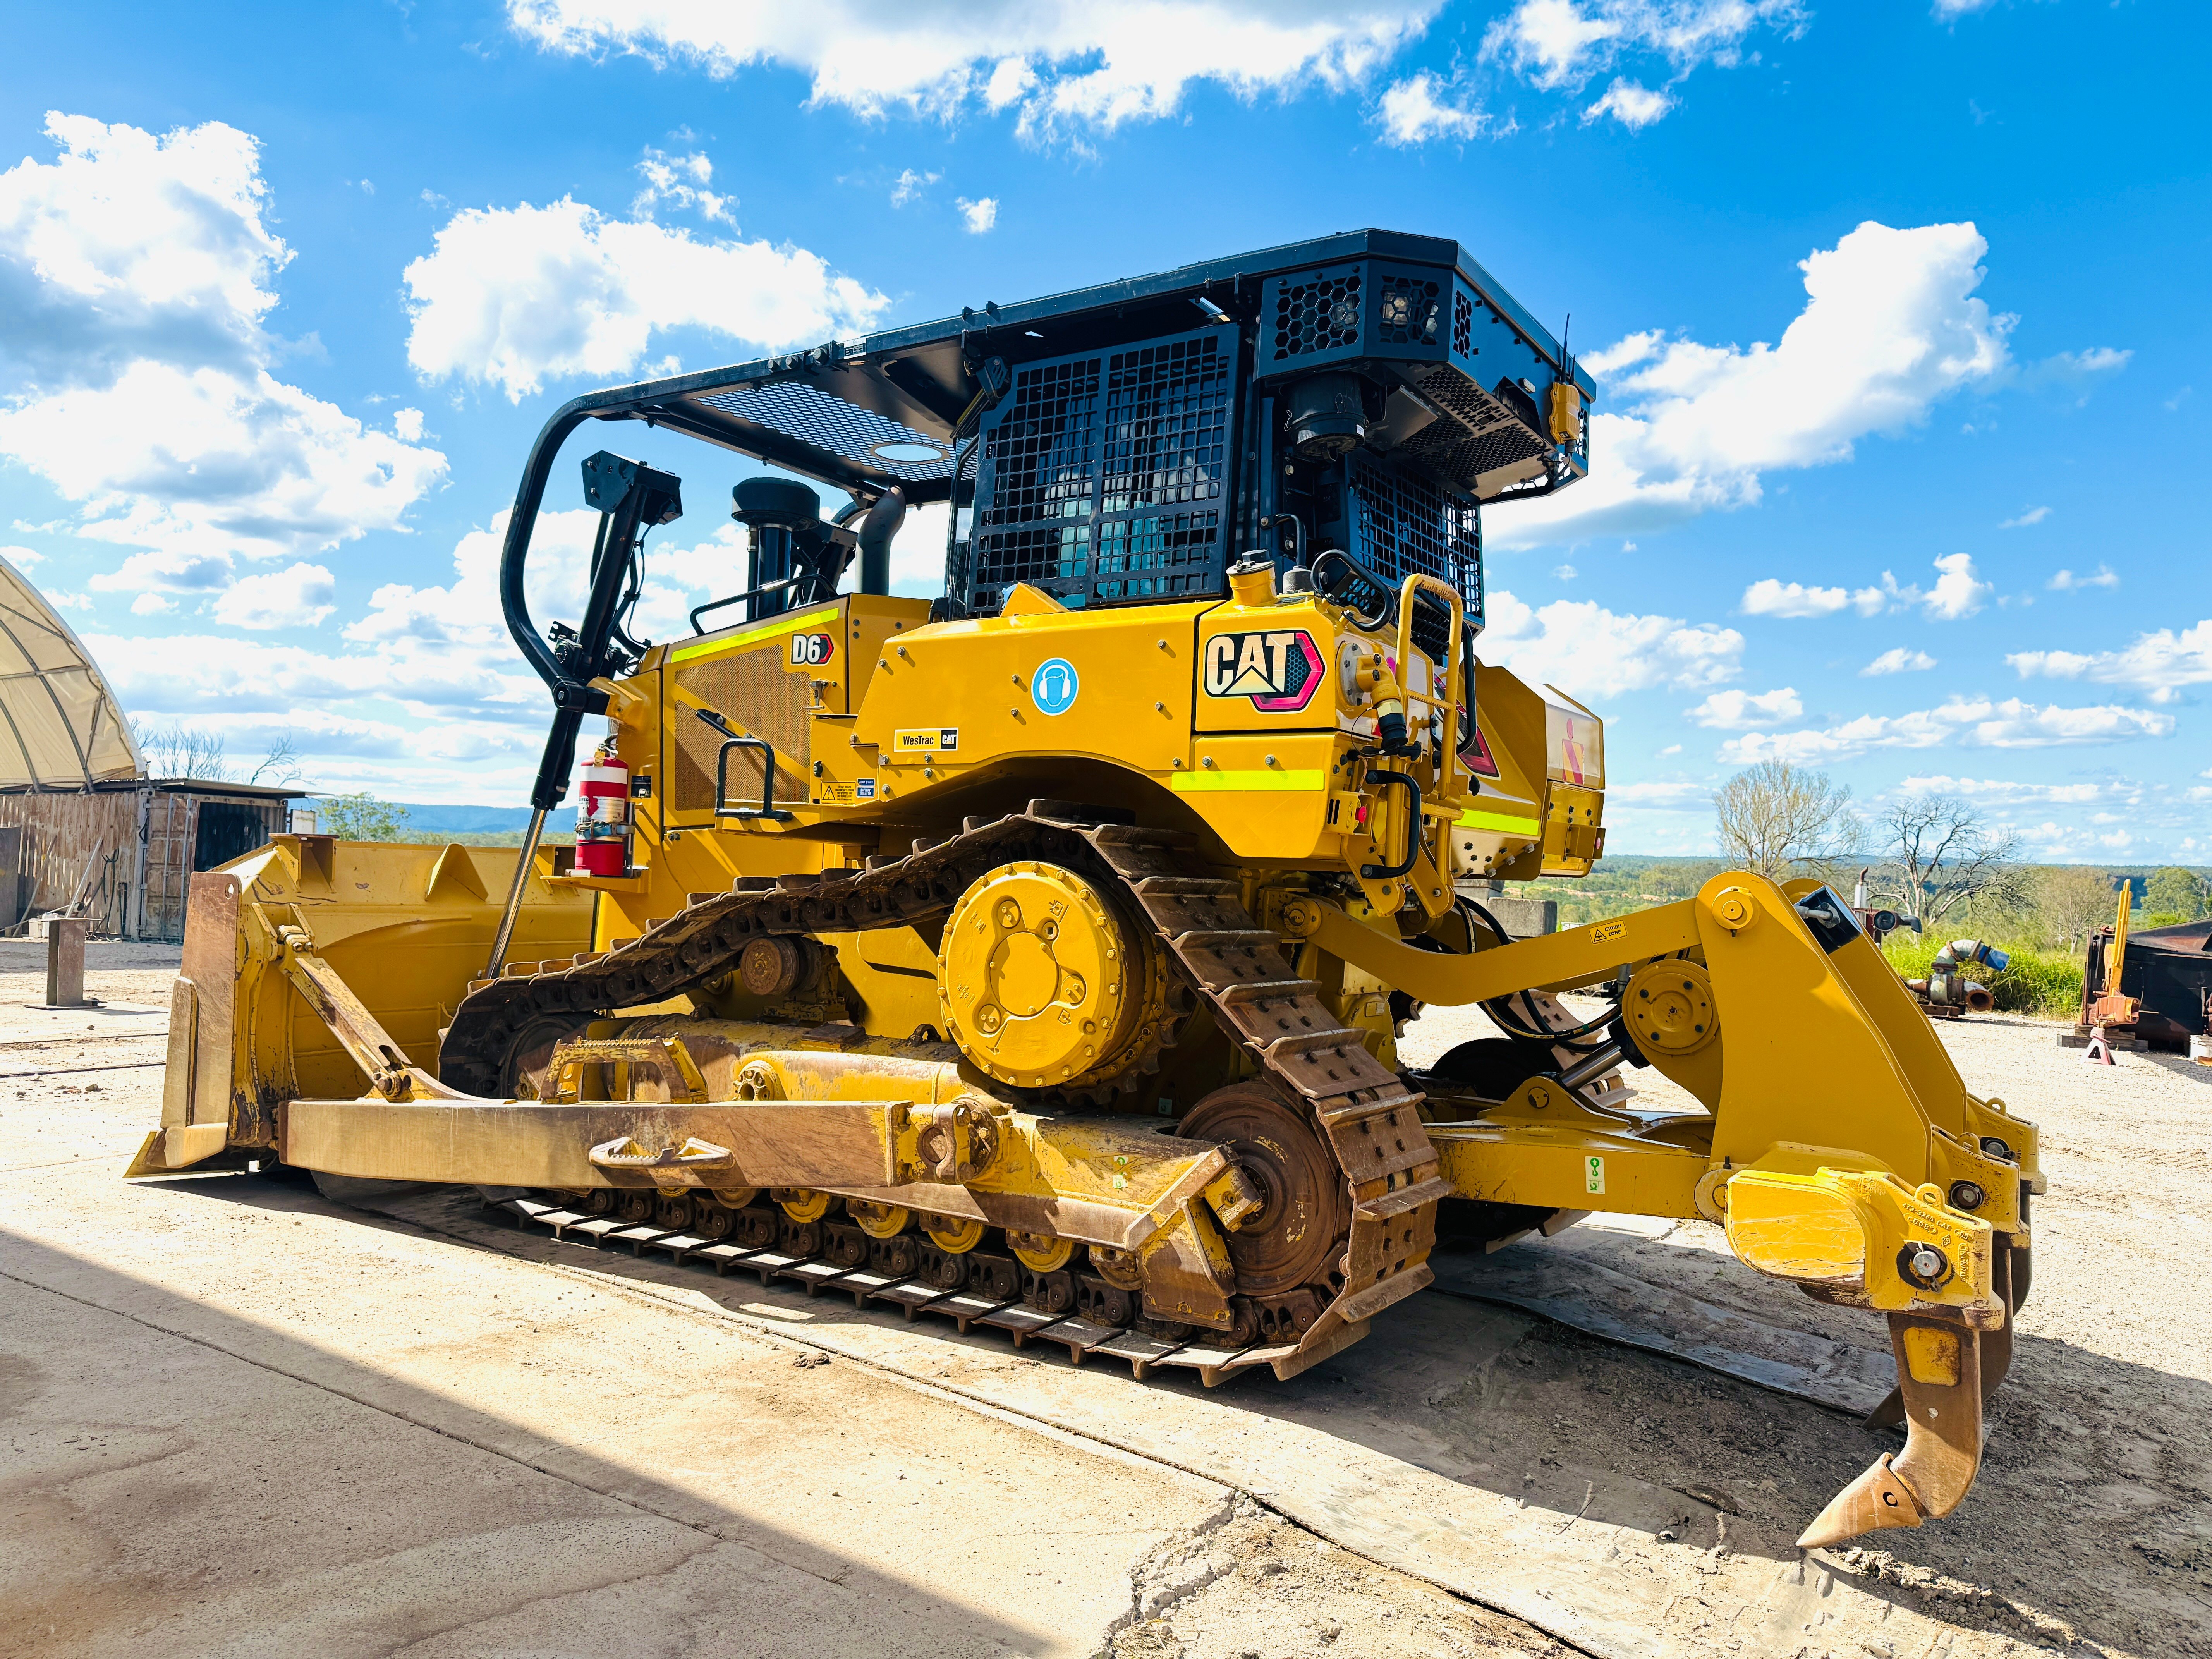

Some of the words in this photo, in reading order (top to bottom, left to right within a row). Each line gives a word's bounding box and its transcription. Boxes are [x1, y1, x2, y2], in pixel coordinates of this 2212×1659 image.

[792, 635, 821, 663] D6
[1207, 632, 1295, 695] CAT
[903, 735, 934, 745] WesTrac
[942, 734, 957, 745] CAT
[1936, 1220, 1951, 1231] CAT
